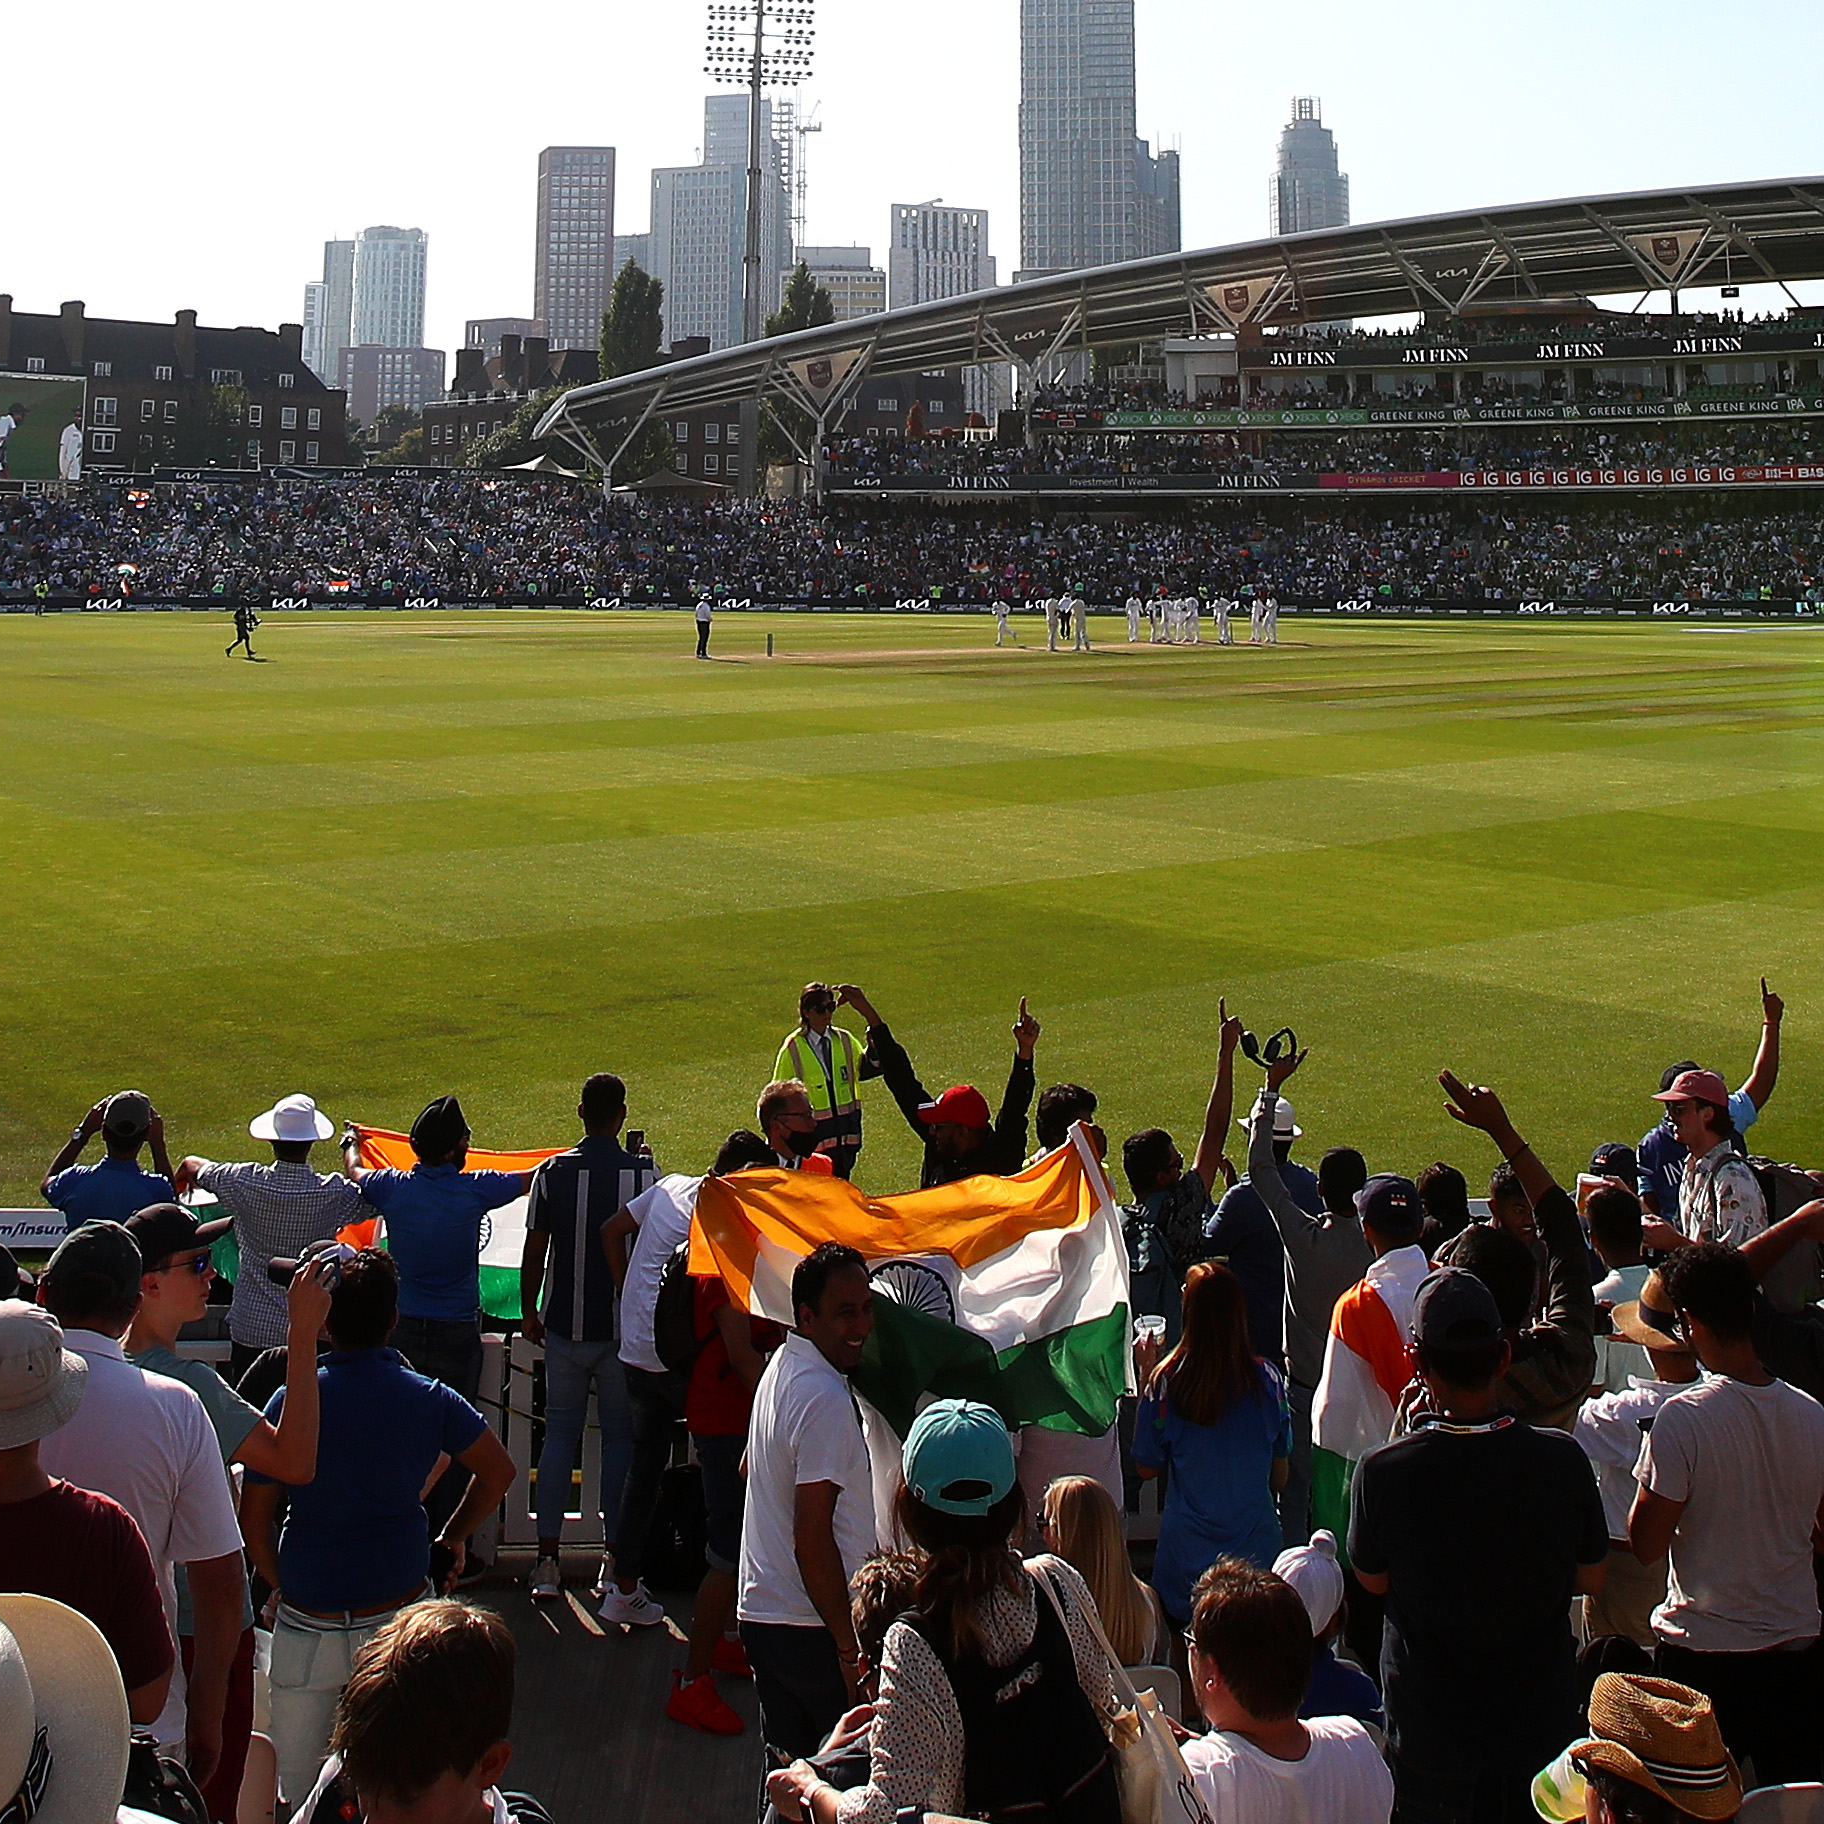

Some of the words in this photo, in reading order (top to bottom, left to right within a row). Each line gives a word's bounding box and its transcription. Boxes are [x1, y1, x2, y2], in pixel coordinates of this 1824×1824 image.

[1537, 345, 1560, 358] JM
[1565, 343, 1604, 357] FINN
[1673, 340, 1698, 353] JM
[1702, 337, 1742, 352] FINN
[1270, 352, 1293, 366] JM
[1297, 351, 1336, 365] FINN
[1403, 349, 1426, 363] JM
[1430, 348, 1468, 362] FINN
[1589, 406, 1631, 416] GREENE
[1635, 404, 1665, 415] KING
[1700, 402, 1745, 413] GREENE
[1749, 401, 1778, 411] KING
[1371, 411, 1413, 422] GREENE
[1417, 410, 1445, 420] KING
[1479, 409, 1521, 419] GREENE
[1525, 408, 1554, 418] KING
[947, 476, 969, 488] JM
[974, 476, 1010, 488] FINN
[1069, 477, 1120, 487] Investment
[1128, 477, 1159, 487] Wealth
[1217, 476, 1240, 488] JM
[1243, 476, 1280, 488] FINN
[1460, 472, 1475, 486] IG
[1483, 472, 1498, 485] IG
[1506, 471, 1521, 485] IG
[1530, 471, 1545, 484] IG
[1553, 470, 1568, 484] IG
[1577, 470, 1592, 483] IG
[1600, 470, 1615, 483] IG
[1623, 469, 1639, 483] IG
[1647, 469, 1662, 482] IG
[1671, 468, 1686, 482] IG
[86, 598, 121, 610] KIA
[272, 597, 308, 609] KIA
[405, 598, 438, 608] KIA
[895, 598, 929, 609] KIA
[1336, 601, 1371, 611] KIA
[1520, 603, 1554, 613] KIA
[1654, 603, 1689, 613] KIA
